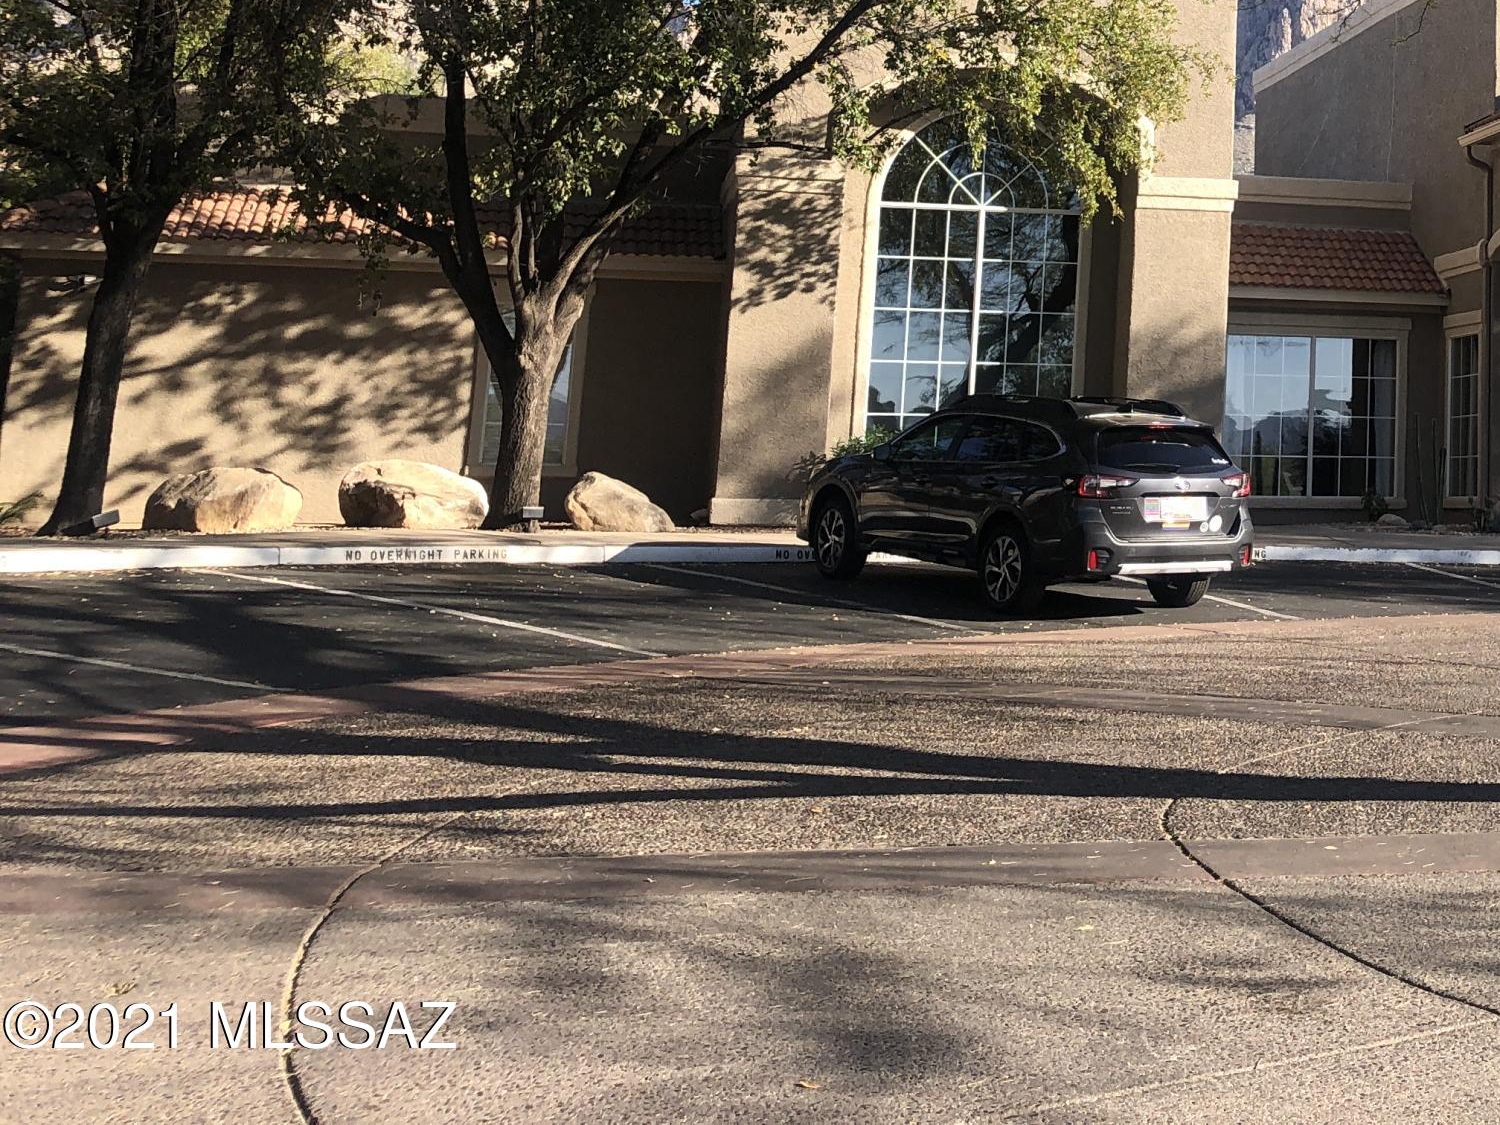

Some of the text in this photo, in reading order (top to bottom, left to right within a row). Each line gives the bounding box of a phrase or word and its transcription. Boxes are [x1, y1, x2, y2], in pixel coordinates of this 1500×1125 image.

[345, 549, 508, 561] NO OVERNIGHT PARKING
[775, 549, 790, 560] NO
